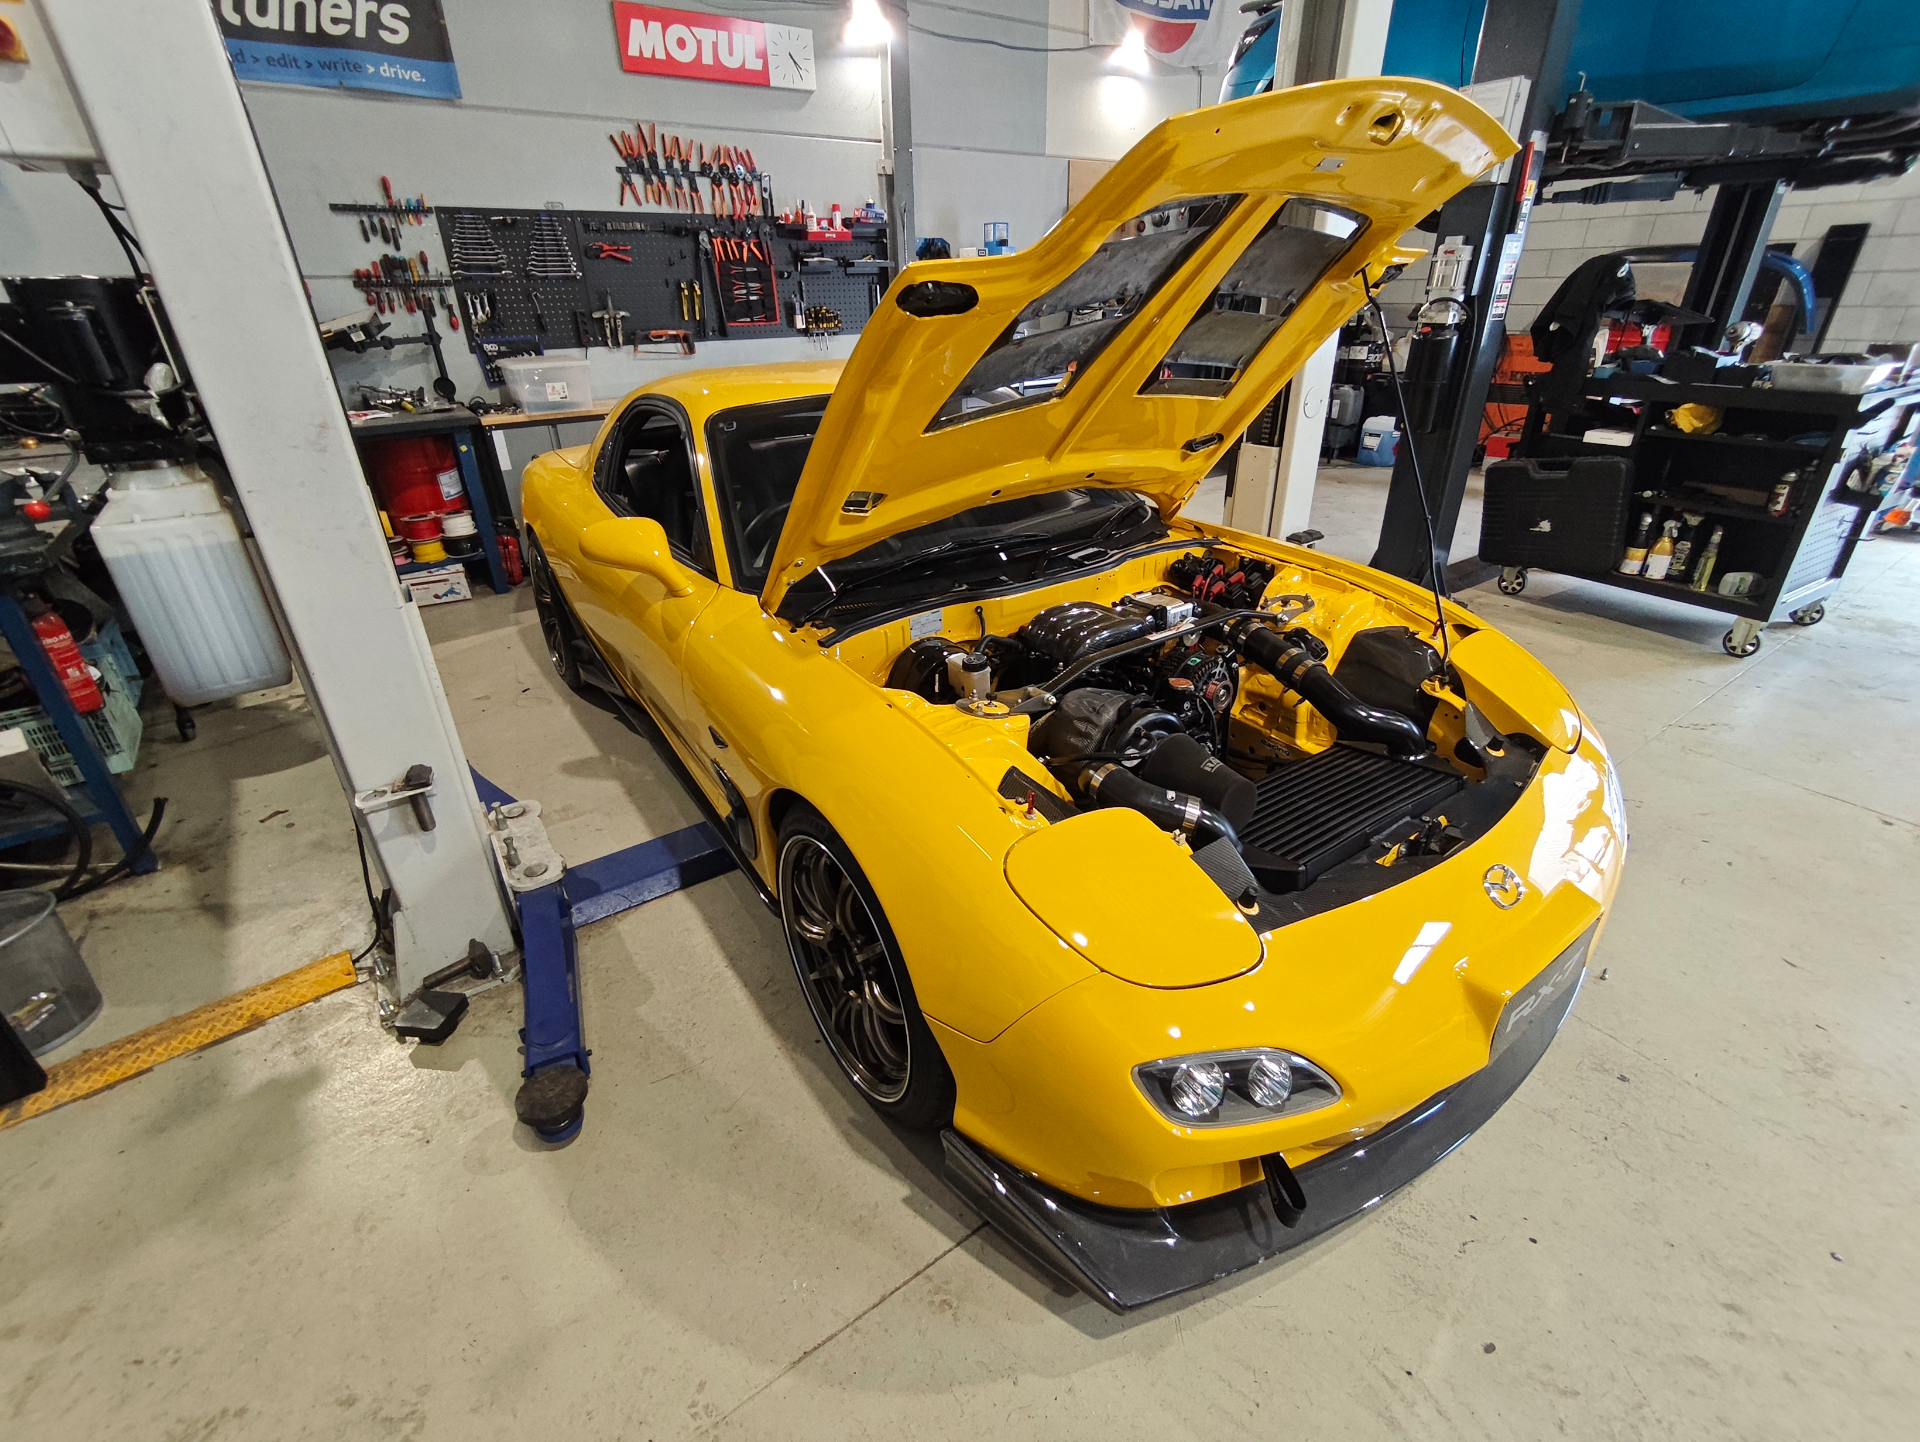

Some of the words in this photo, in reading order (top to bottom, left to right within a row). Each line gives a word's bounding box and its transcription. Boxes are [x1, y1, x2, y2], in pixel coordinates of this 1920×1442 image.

[627, 18, 764, 71] MOTUL
[266, 52, 301, 70] edit
[317, 57, 363, 73] write
[379, 62, 426, 83] drive.
